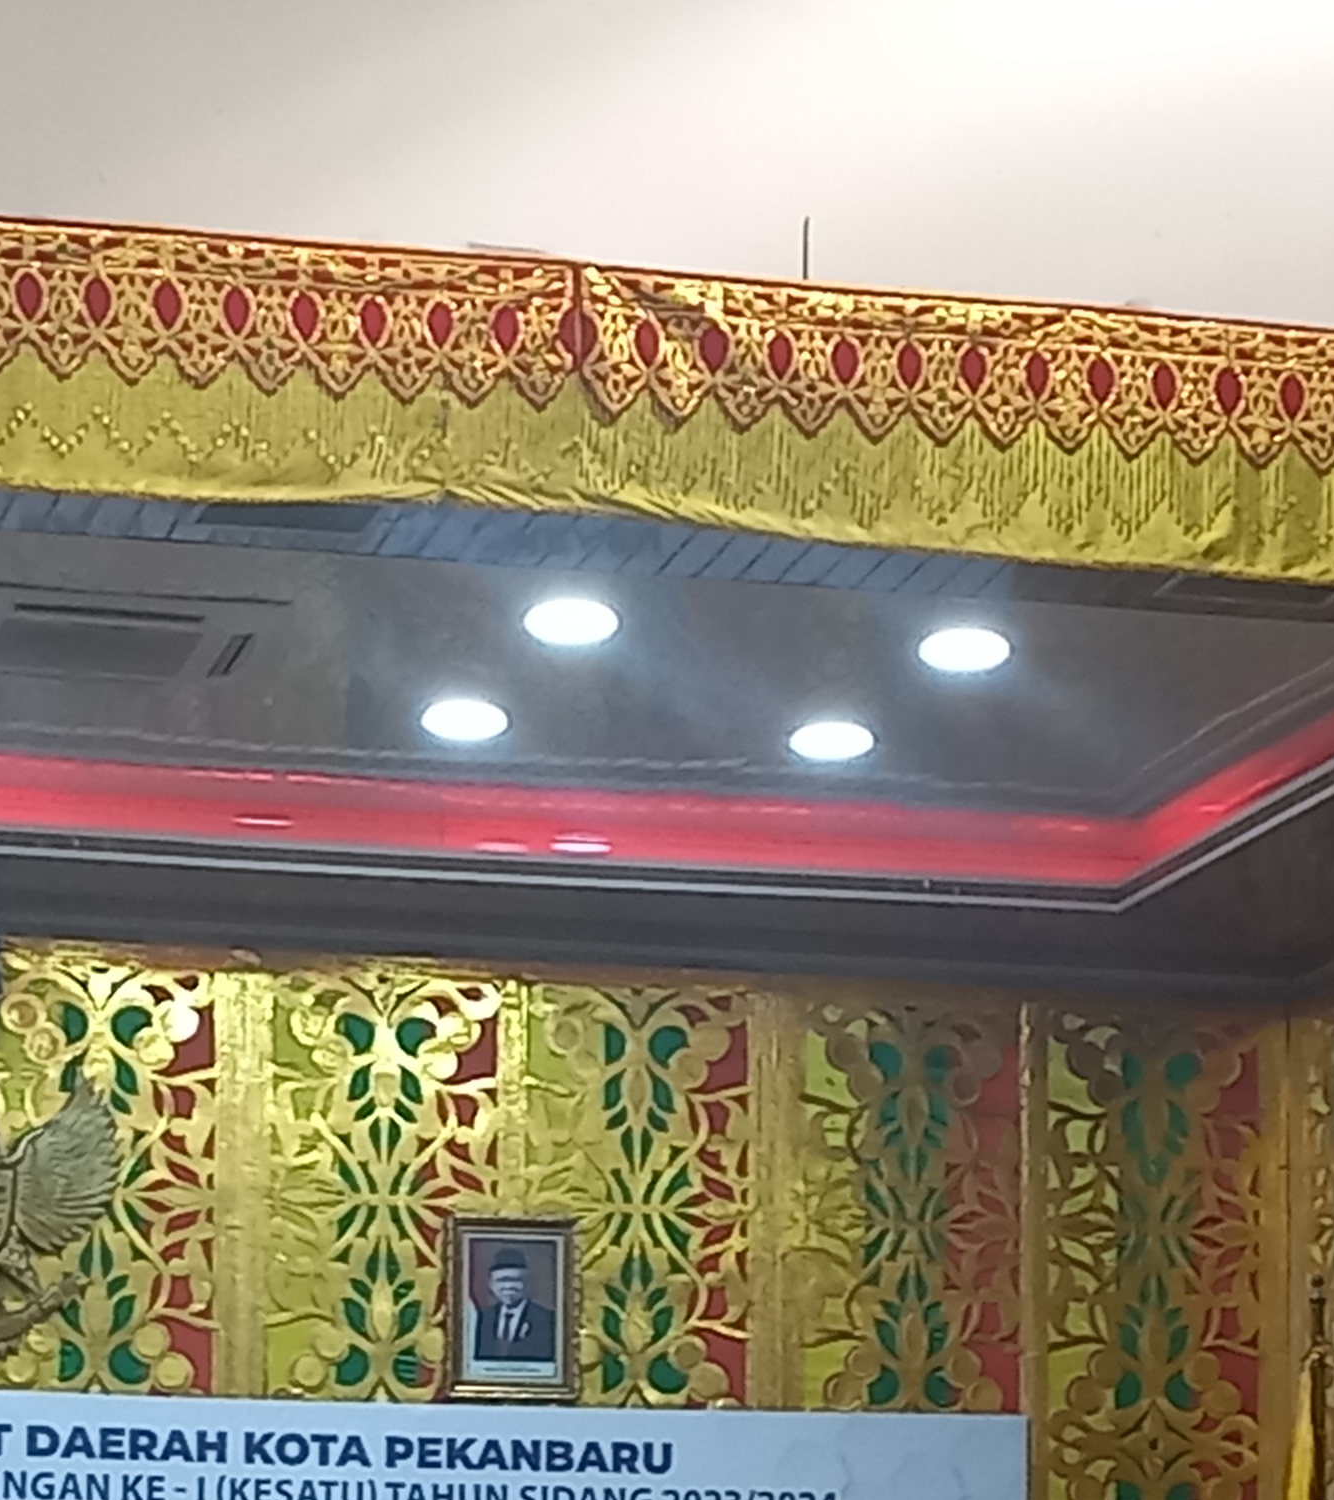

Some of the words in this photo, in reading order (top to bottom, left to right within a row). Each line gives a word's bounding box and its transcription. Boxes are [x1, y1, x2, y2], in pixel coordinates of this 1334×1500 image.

[26, 1425, 228, 1464] DAERAH
[244, 1431, 372, 1468] KOTA
[384, 1435, 673, 1475] PEKANBARU
